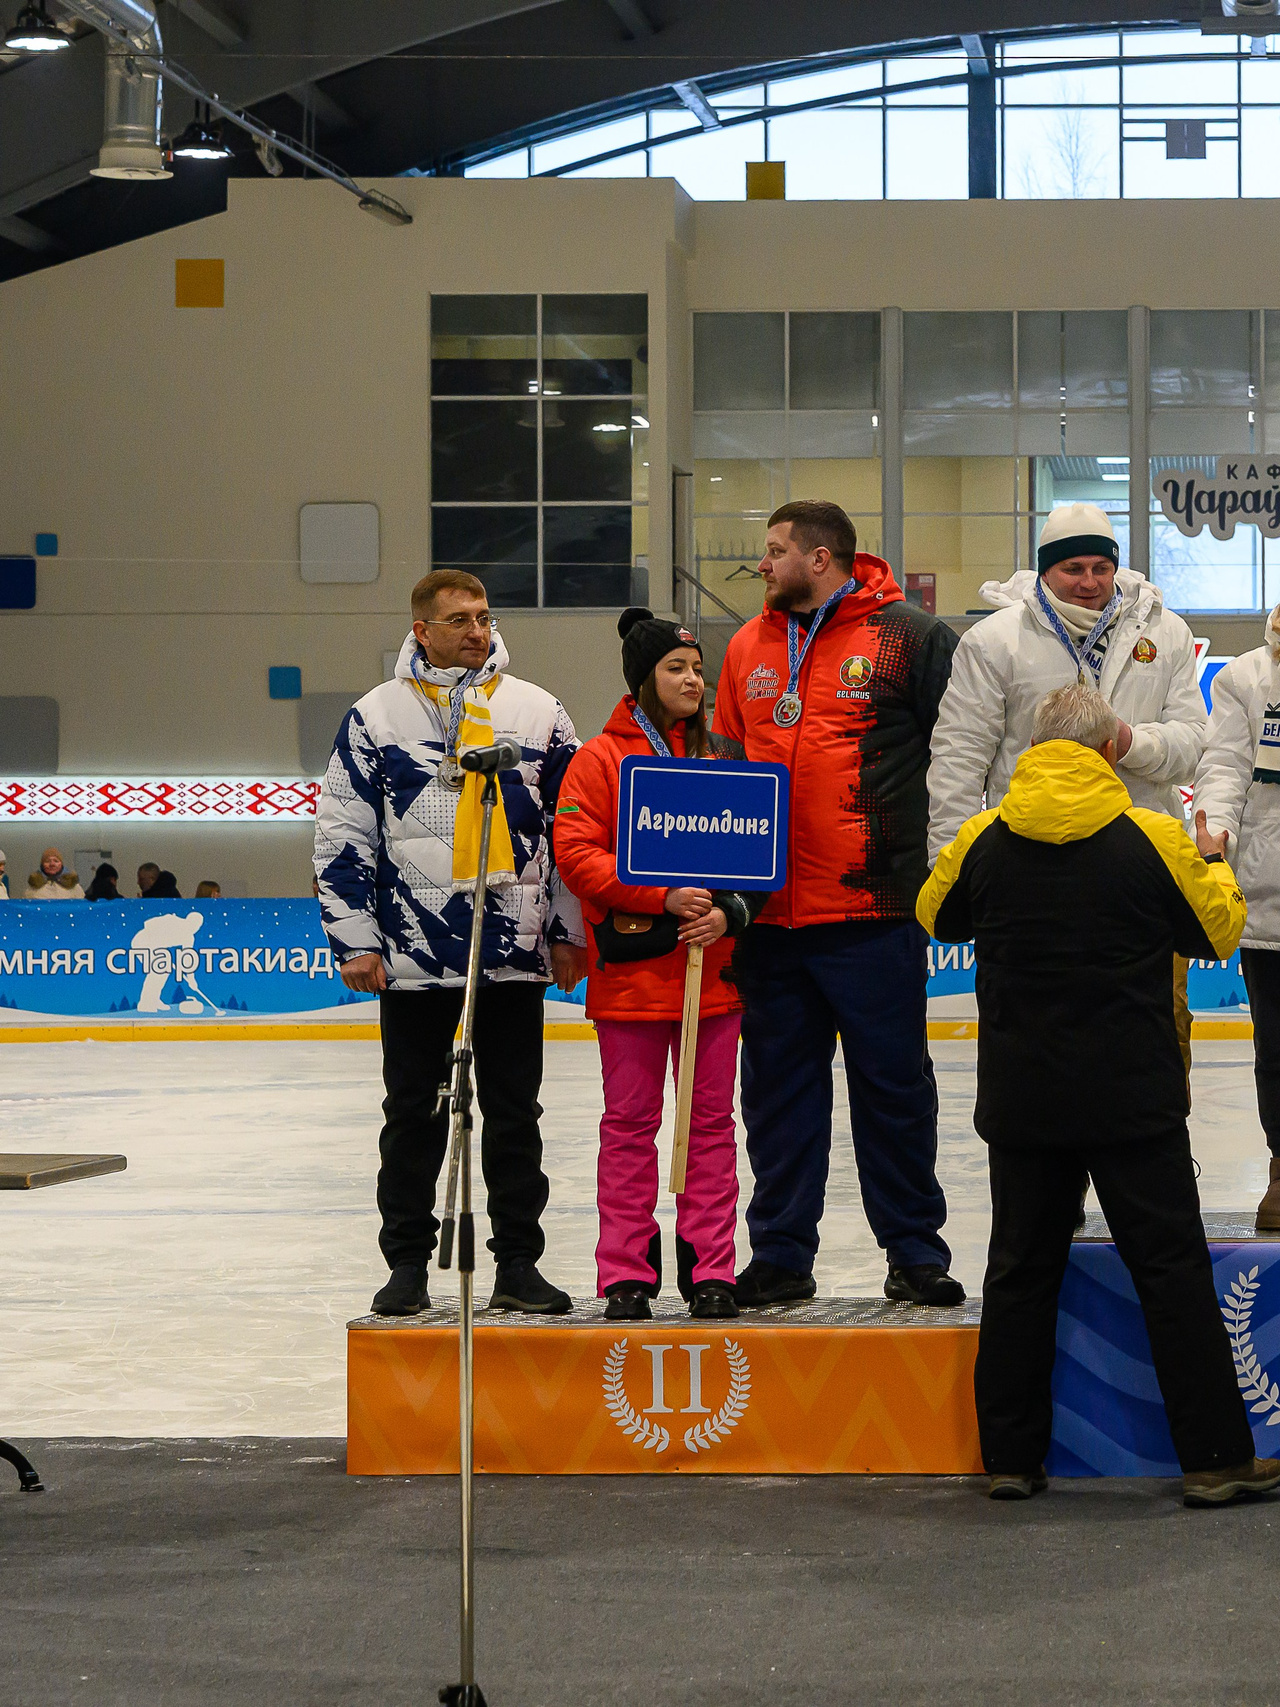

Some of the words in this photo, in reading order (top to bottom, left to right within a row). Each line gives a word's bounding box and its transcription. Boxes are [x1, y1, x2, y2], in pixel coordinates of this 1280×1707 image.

[836, 690, 871, 700] BELARUS
[637, 806, 769, 838] Агрохолдинг
[641, 1344, 711, 1413] II
